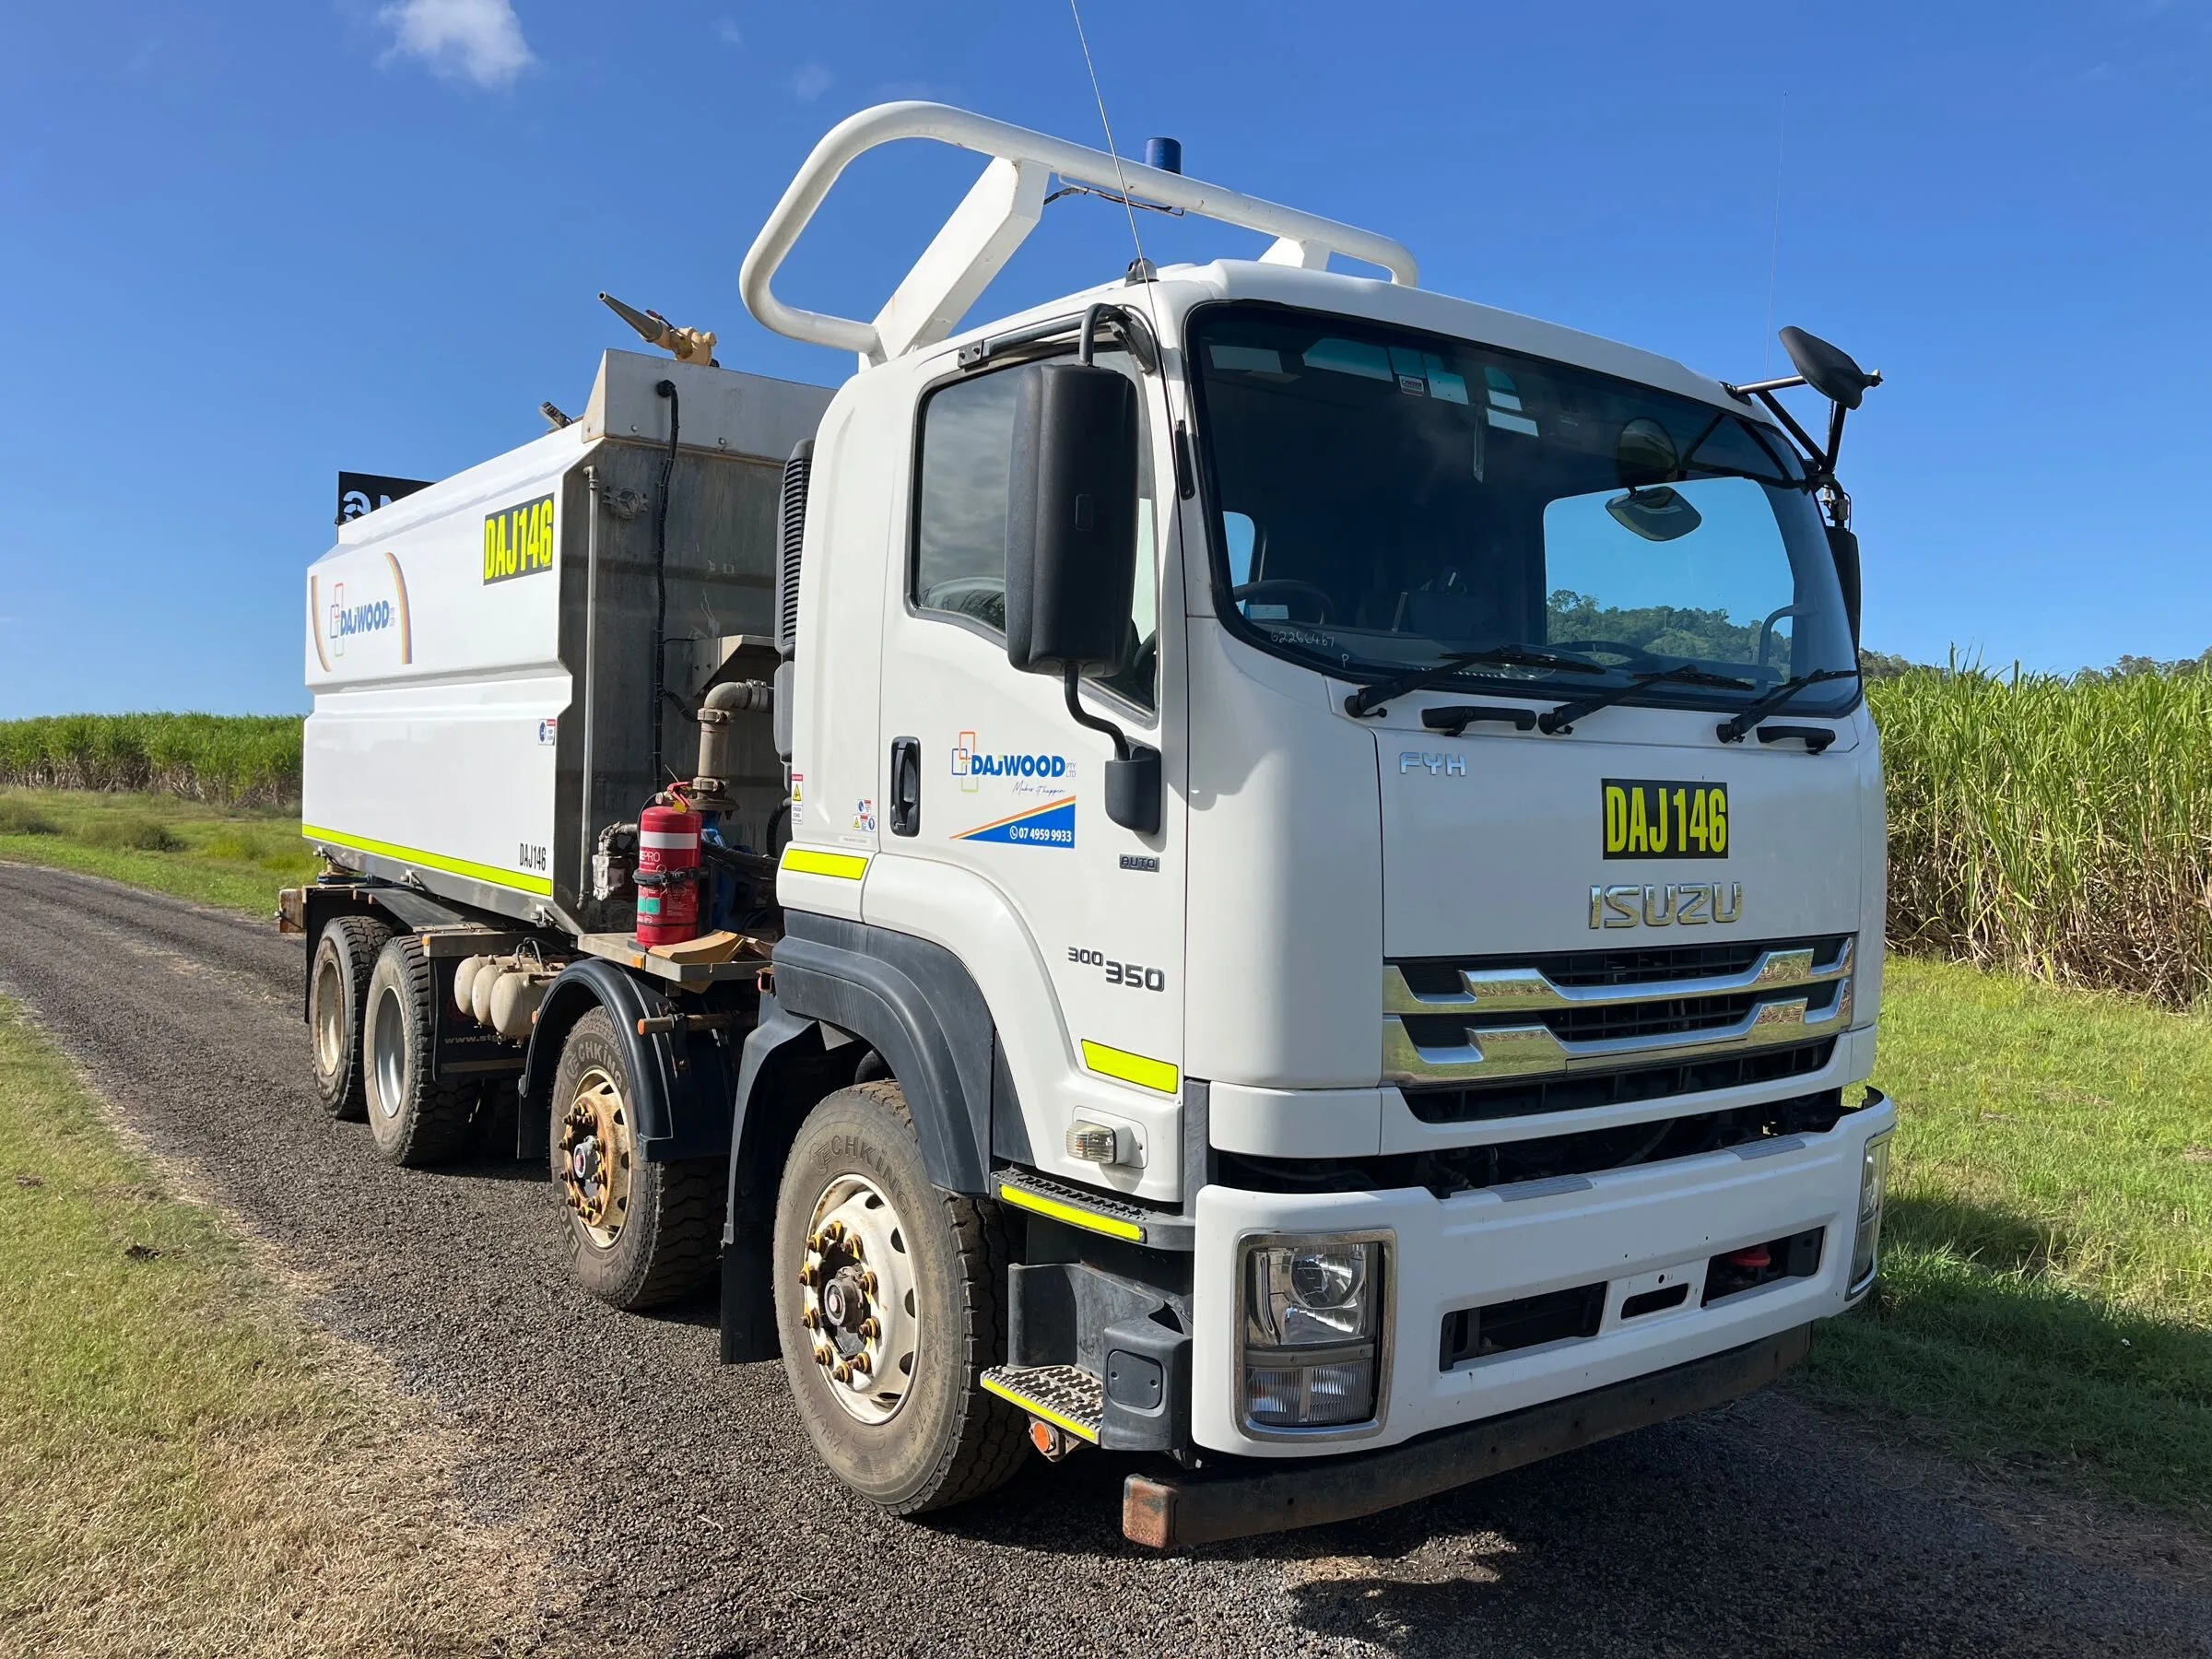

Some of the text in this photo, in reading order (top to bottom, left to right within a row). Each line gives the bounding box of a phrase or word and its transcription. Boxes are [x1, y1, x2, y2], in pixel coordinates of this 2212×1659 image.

[485, 499, 552, 580] DAJ146
[1399, 751, 1466, 776] FYH
[1018, 827, 1072, 842] 07 4959 9933
[1606, 786, 1726, 853] DAJ146
[519, 842, 546, 871] DAJ146
[1121, 855, 1156, 869] AUTO
[1589, 881, 1743, 929] ISUZU
[1068, 947, 1165, 992] 300 350
